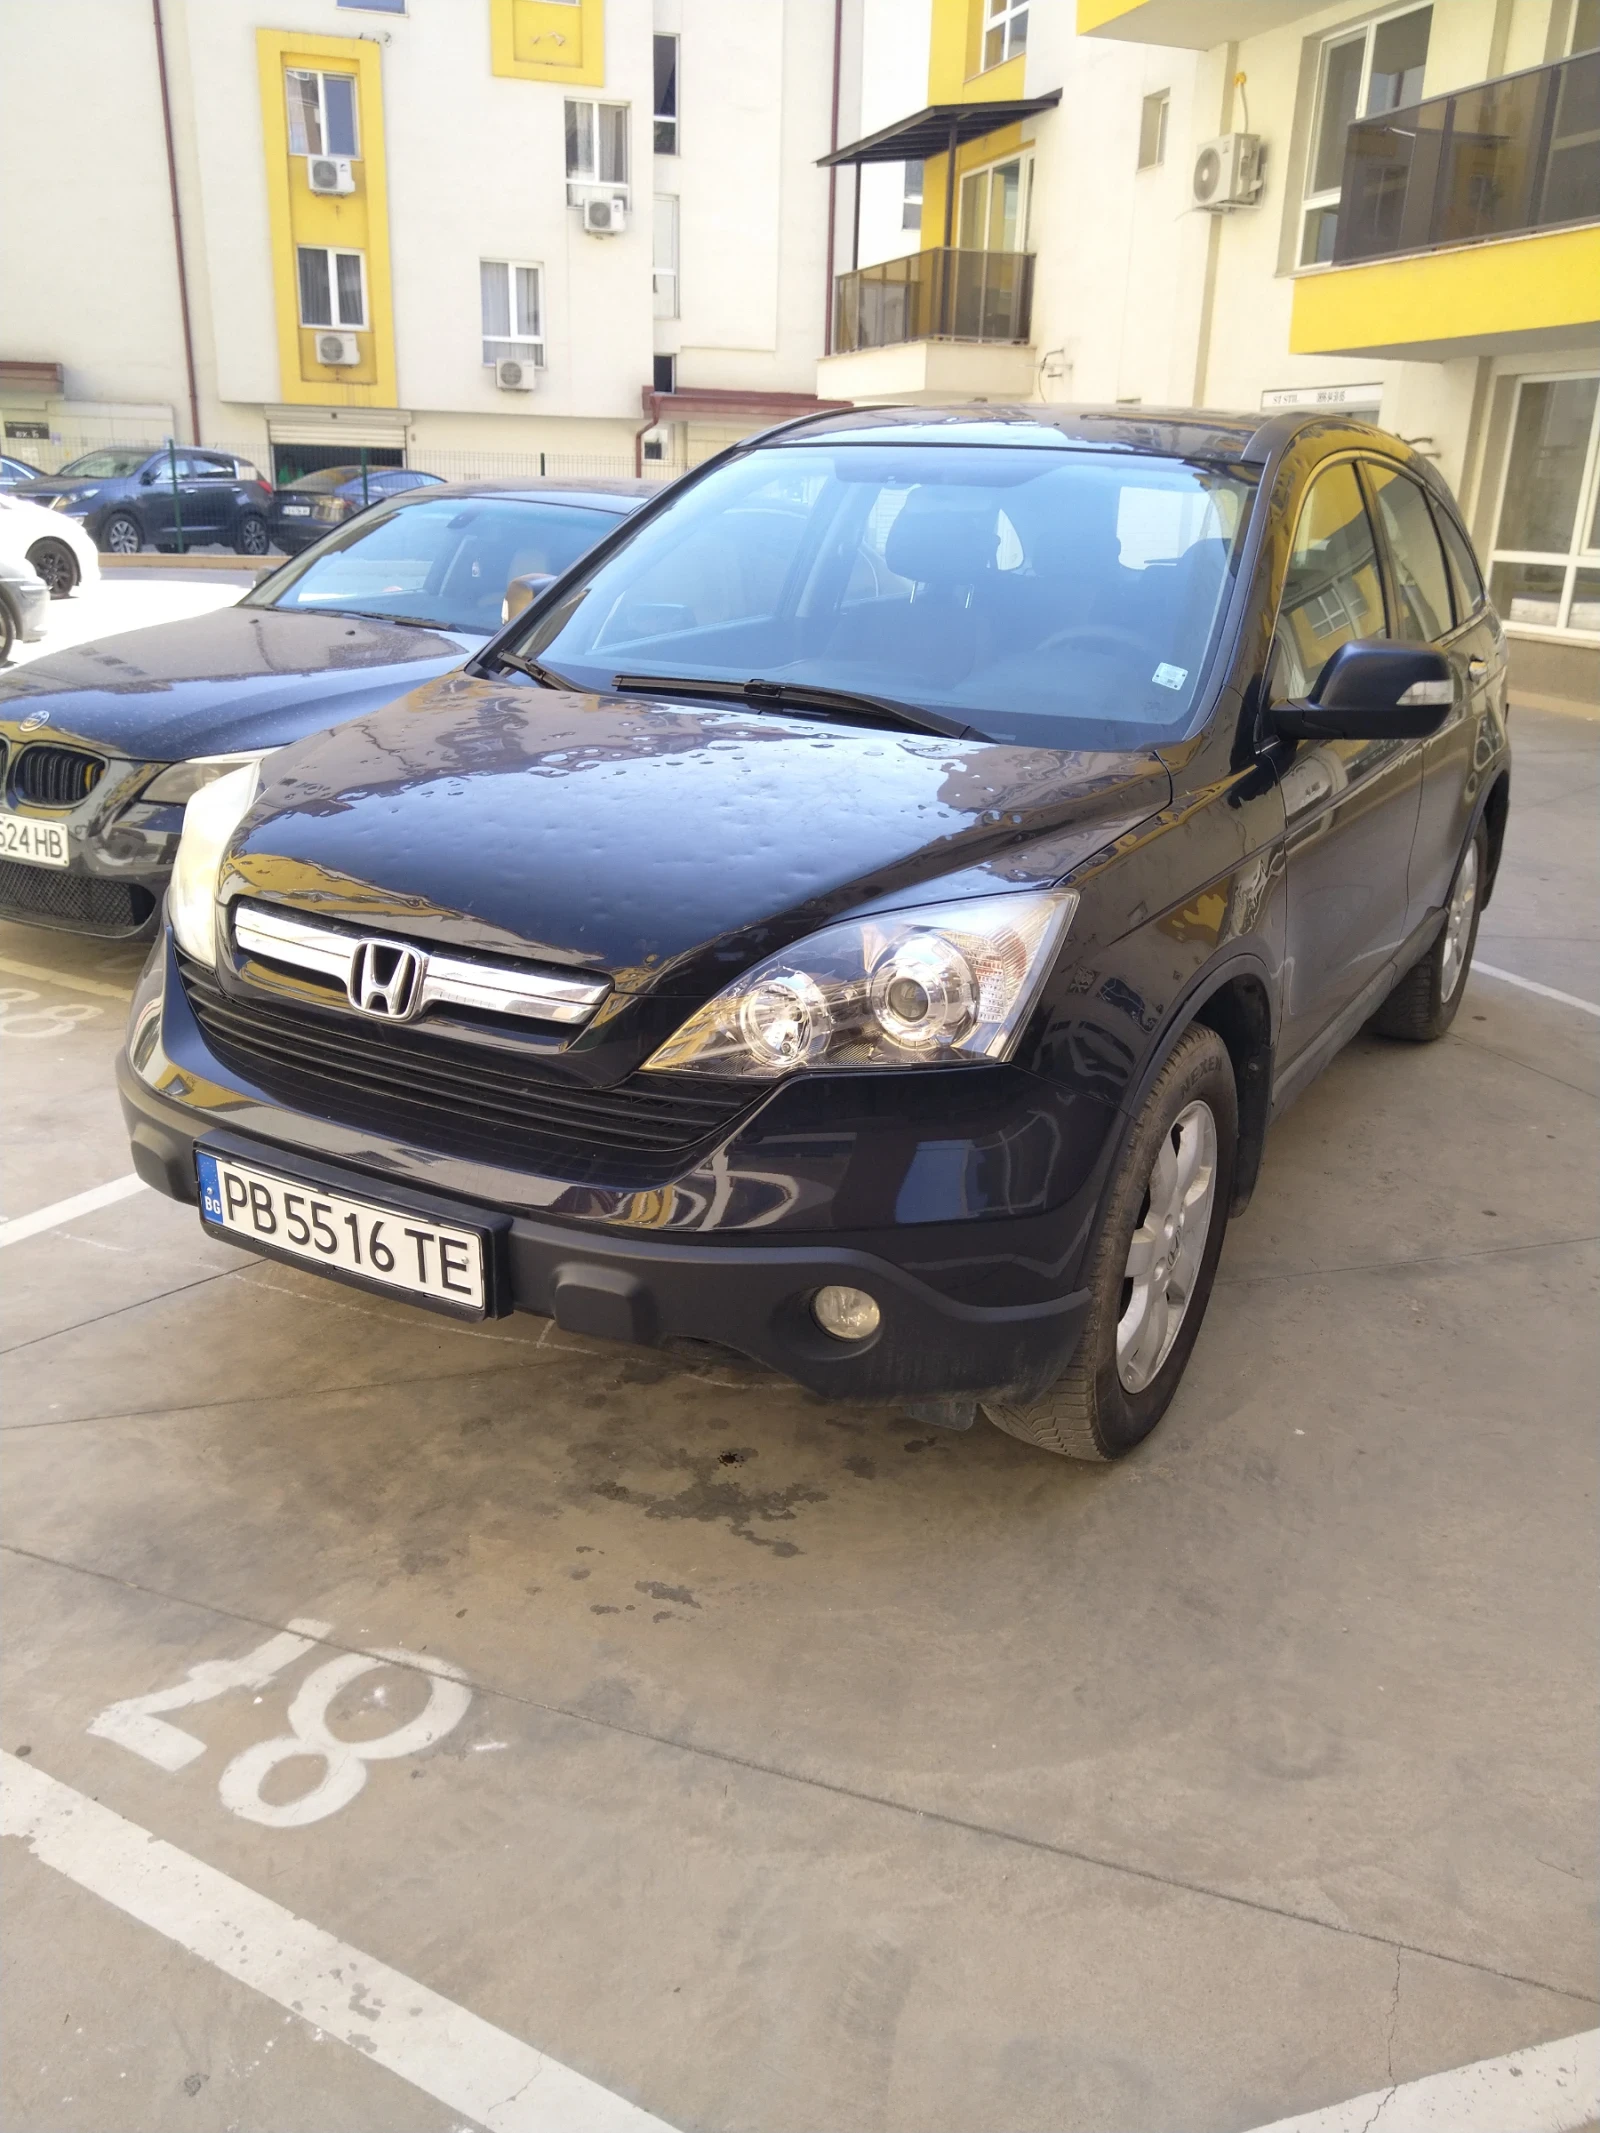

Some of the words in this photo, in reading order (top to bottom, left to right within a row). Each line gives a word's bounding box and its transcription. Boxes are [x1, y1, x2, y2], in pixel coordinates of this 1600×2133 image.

[34, 827, 63, 858] HB
[1180, 1056, 1223, 1100] NEXEN
[204, 1194, 221, 1214] BG
[223, 1171, 277, 1234] PB
[283, 1192, 395, 1272] 5516
[404, 1227, 473, 1296] TE
